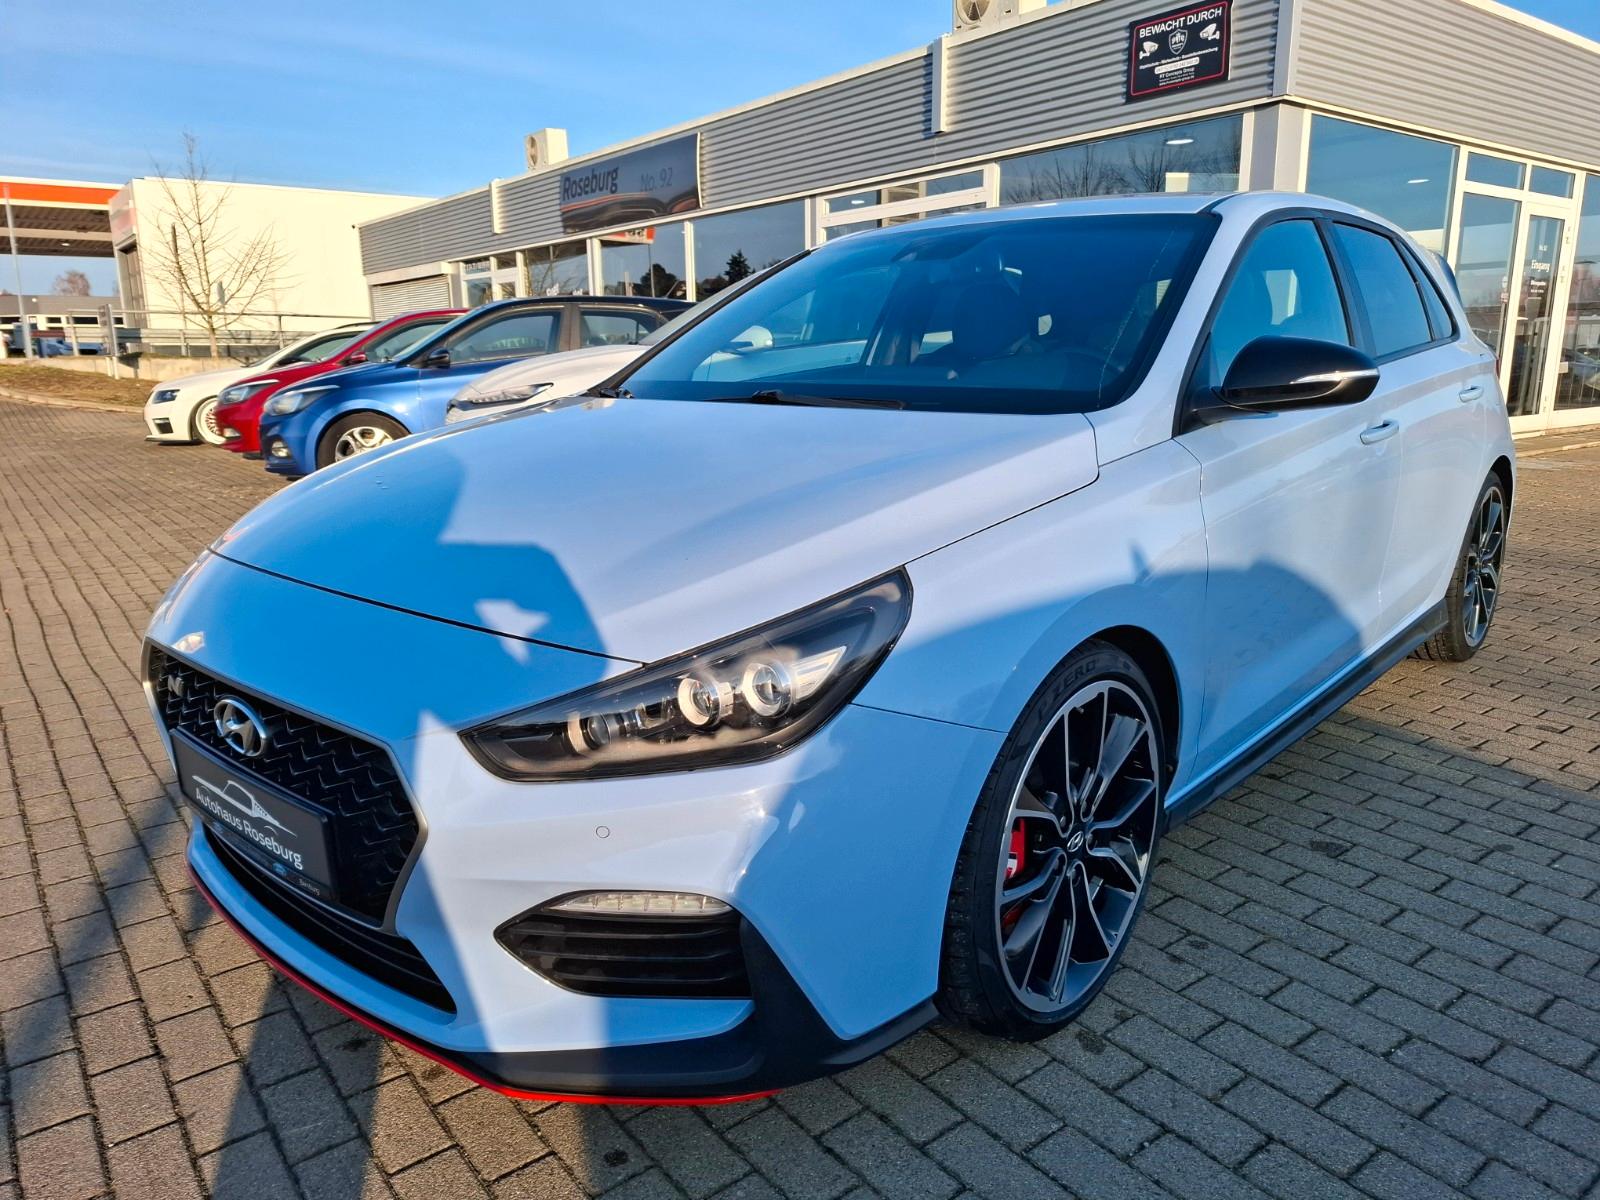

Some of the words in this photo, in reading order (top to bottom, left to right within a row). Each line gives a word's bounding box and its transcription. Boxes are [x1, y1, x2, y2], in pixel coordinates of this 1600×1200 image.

[1139, 17, 1186, 38] BEWACHT
[1187, 7, 1223, 25] DURCH
[562, 166, 619, 200] Roseburg
[659, 167, 673, 188] 92
[1531, 259, 1551, 272] Eingang
[195, 787, 243, 830] Autohaus
[244, 821, 303, 870] Roseburg
